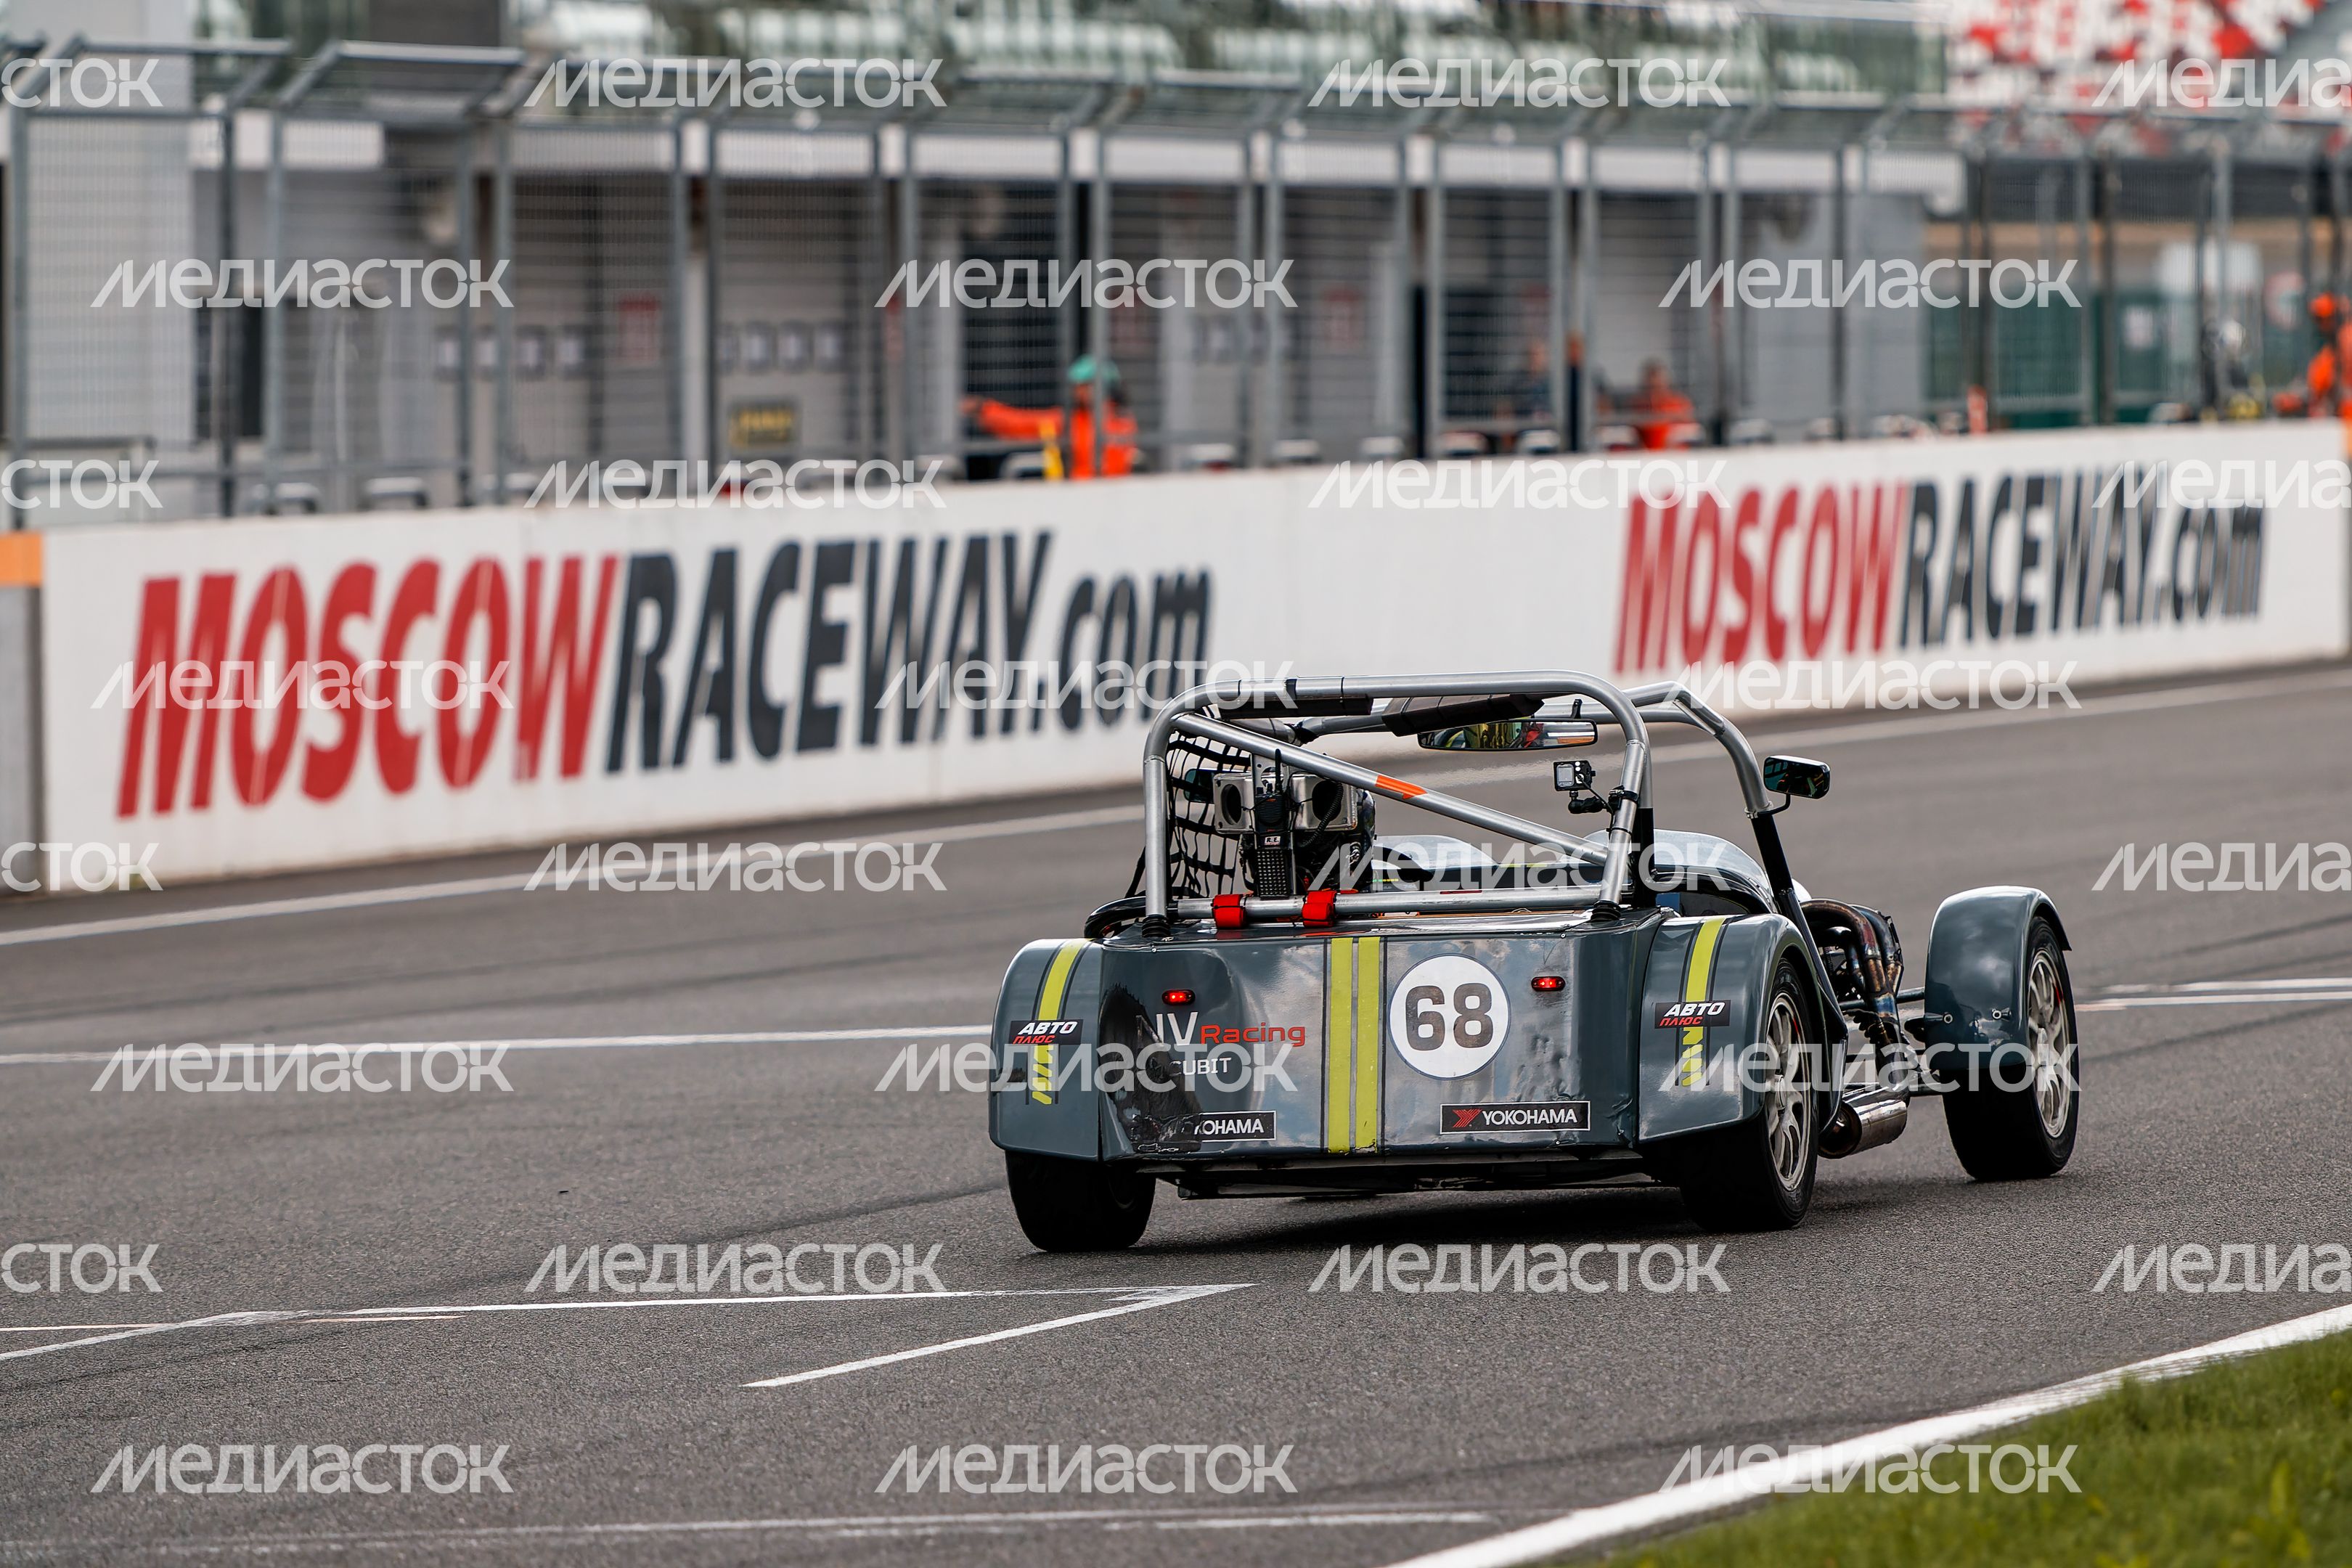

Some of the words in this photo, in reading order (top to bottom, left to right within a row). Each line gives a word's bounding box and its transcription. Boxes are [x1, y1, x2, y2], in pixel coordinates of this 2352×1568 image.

[1405, 982, 1493, 1051] 68
[1200, 1022, 1306, 1048] Racing
[1194, 1118, 1265, 1135] OHAMA
[1482, 1108, 1577, 1125] YOKOHAMA
